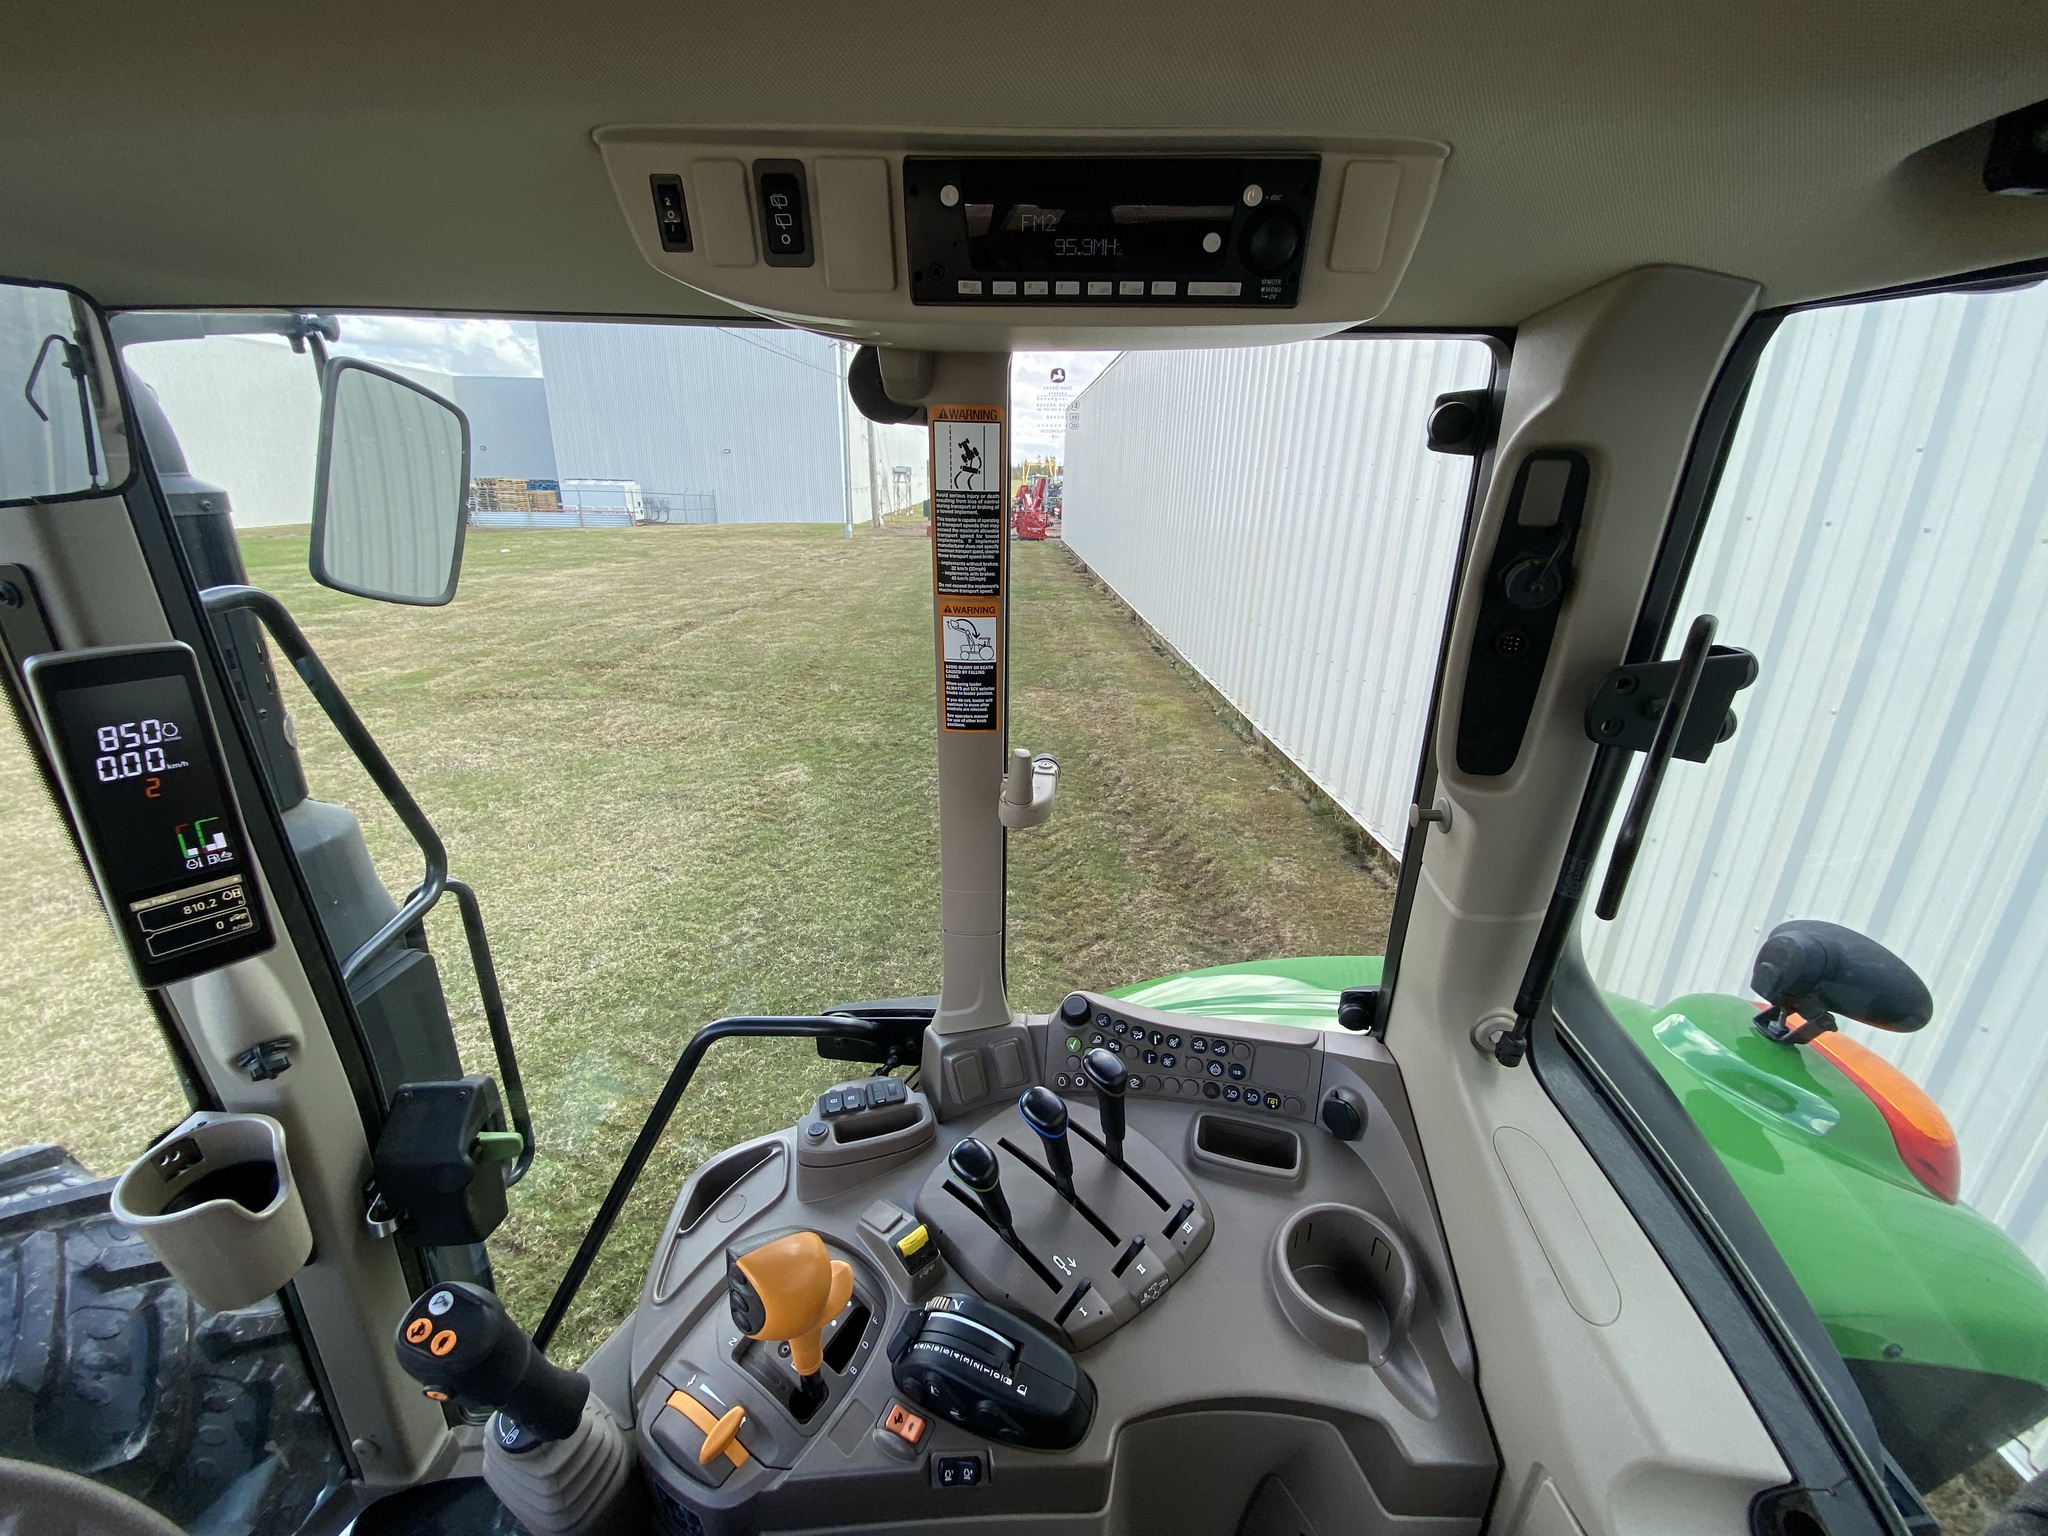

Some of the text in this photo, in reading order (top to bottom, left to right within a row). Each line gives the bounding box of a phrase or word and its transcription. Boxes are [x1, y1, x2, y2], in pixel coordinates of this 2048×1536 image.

[664, 198, 671, 206] 2
[1021, 214, 1056, 232] FM2
[948, 409, 998, 420] WARNING
[97, 718, 162, 752] 850
[96, 747, 189, 782] 0.00 km/h
[144, 777, 161, 798] 2
[183, 898, 218, 915] 810.2
[216, 920, 224, 930] 0
[872, 1316, 878, 1325] F
[728, 1337, 738, 1347] N
[862, 1340, 869, 1350] D
